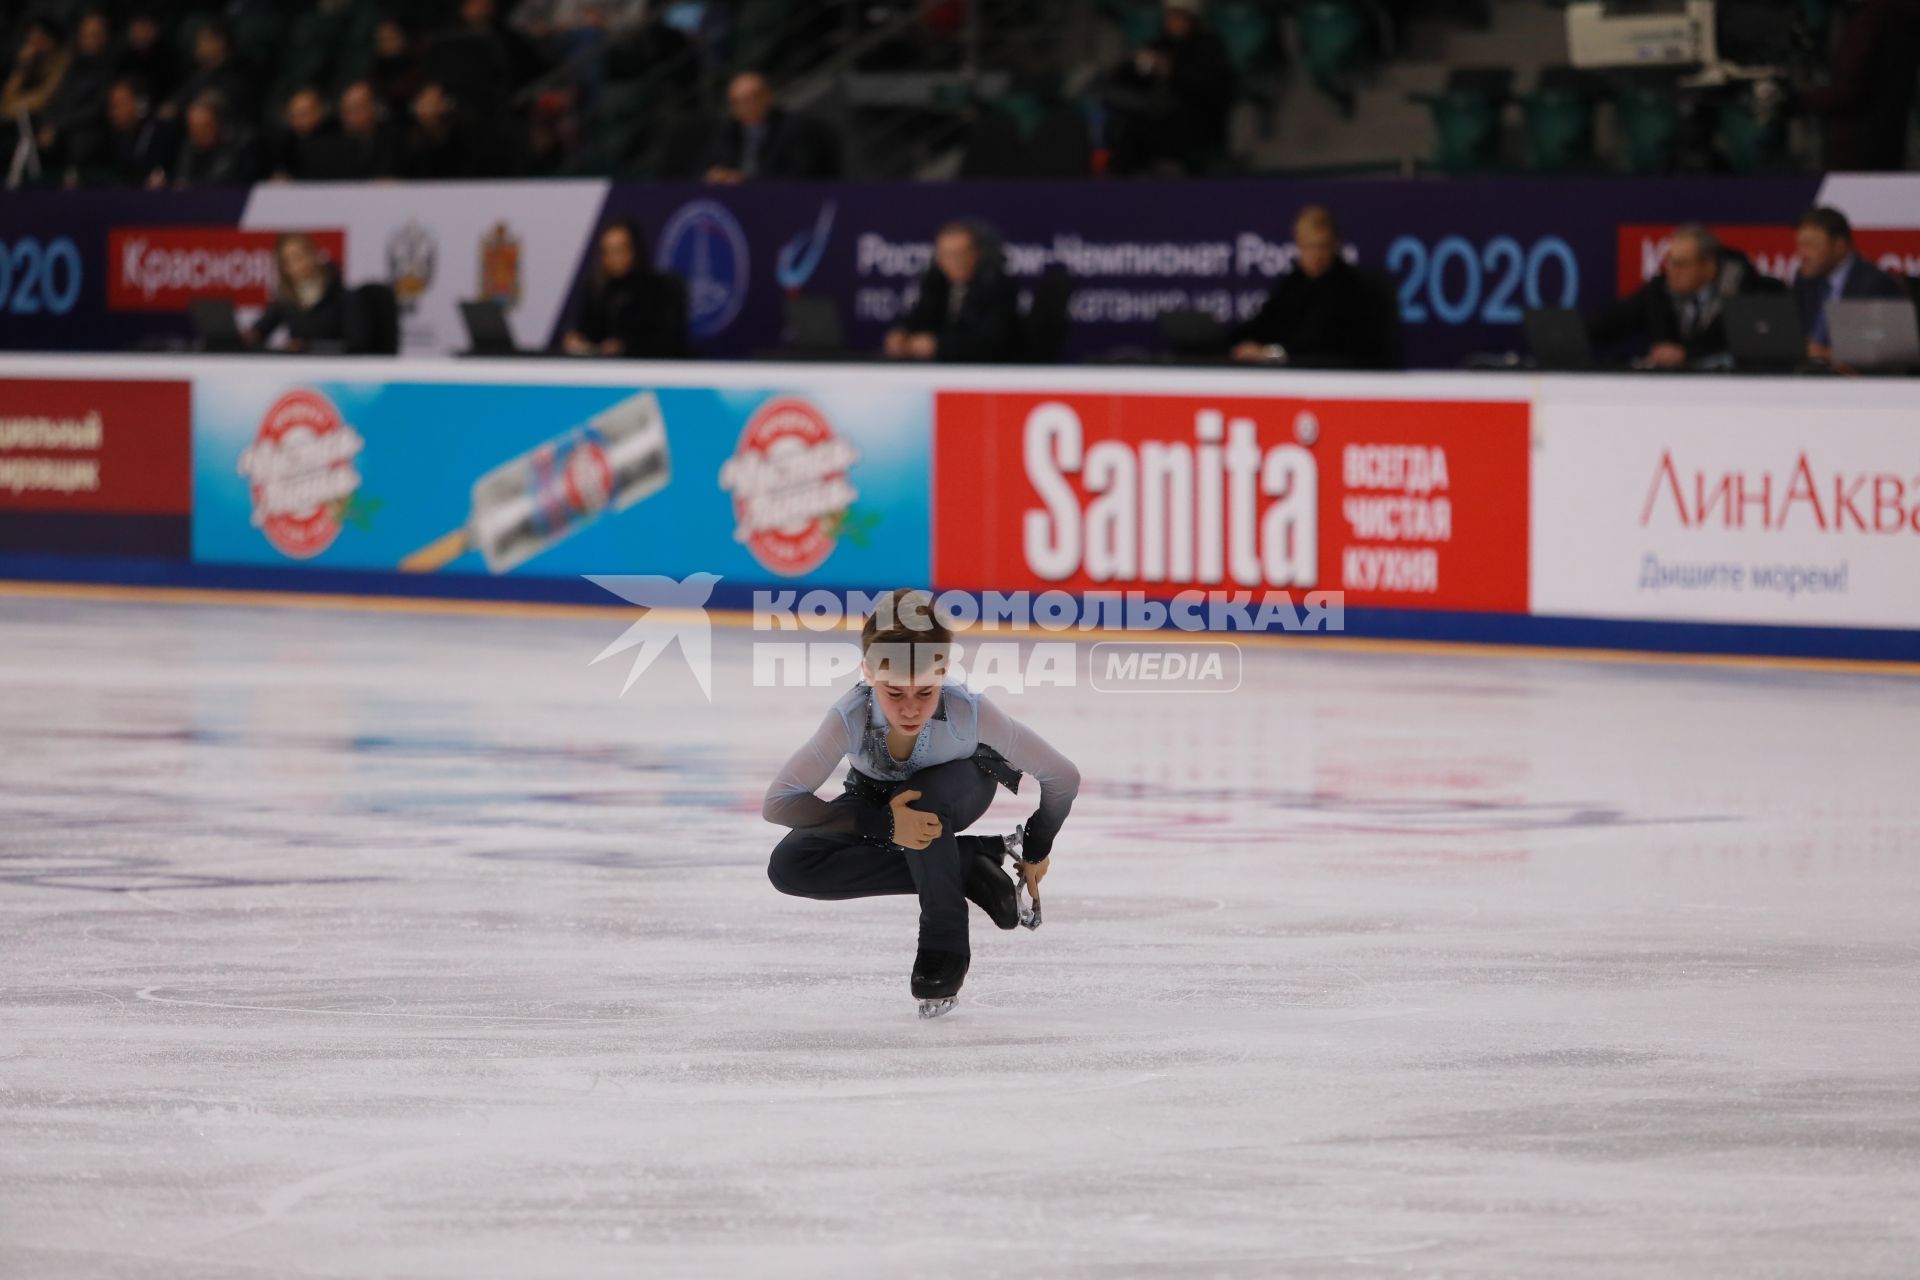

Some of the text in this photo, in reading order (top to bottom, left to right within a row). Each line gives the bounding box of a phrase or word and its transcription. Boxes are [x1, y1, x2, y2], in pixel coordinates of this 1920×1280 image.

[120, 236, 279, 300] Красноя
[1386, 235, 1580, 323] 2020
[1343, 445, 1449, 490] ВСЕГДА
[1023, 402, 1318, 588] Sanita
[1343, 498, 1451, 541] ЧИСТАЯ
[1342, 548, 1438, 592] КУХНЯ
